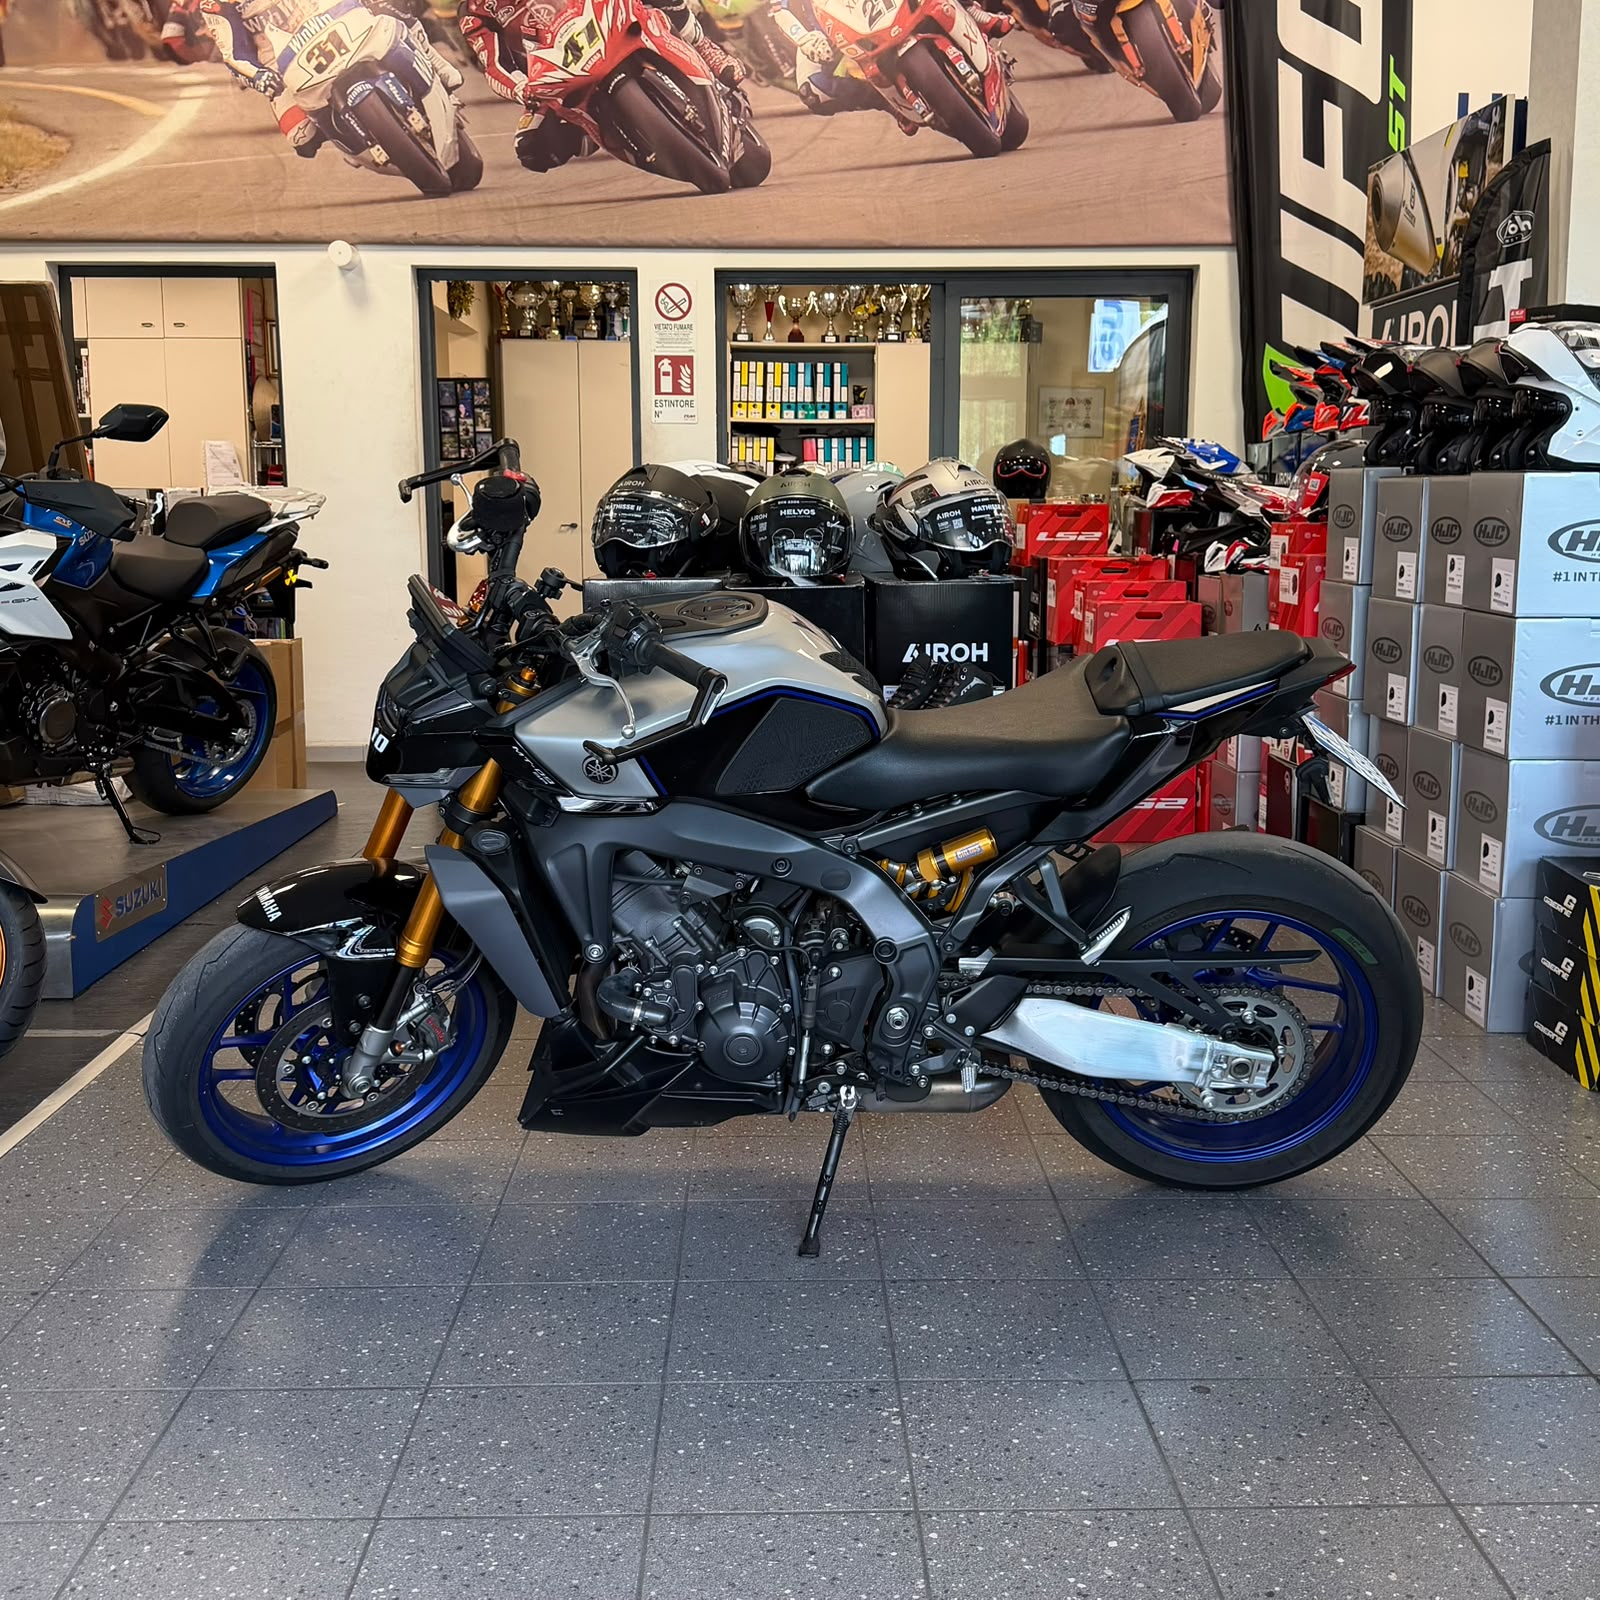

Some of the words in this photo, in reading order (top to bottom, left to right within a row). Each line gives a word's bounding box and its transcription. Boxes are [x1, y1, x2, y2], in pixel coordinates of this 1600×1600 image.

[288, 13, 334, 52] WinWin
[562, 18, 600, 68] 41
[305, 30, 350, 75] 31
[582, 51, 602, 72] YAMAHA
[654, 323, 673, 331] VIETATO
[674, 323, 694, 331] FUMARE
[654, 399, 695, 408] ESTINTORE
[654, 410, 662, 418] N°
[618, 480, 645, 488] AIROH
[750, 513, 768, 522] AIROH
[780, 508, 816, 516] HELYOS
[936, 510, 962, 520] AIROH
[1335, 511, 1352, 524] HJC
[78, 529, 97, 546] SUZ
[1036, 531, 1104, 542] LS2
[1386, 523, 1410, 536] HJC
[1434, 523, 1459, 537] HJC
[1476, 524, 1507, 540] HJC
[1564, 530, 1600, 552] H
[1552, 571, 1571, 583] #1
[1573, 571, 1587, 583] IN
[1324, 622, 1342, 637] HJC
[902, 642, 989, 663] AIROH
[1375, 642, 1399, 658] HJC
[1426, 652, 1451, 668] HJC
[1470, 661, 1500, 680] HJC
[1545, 714, 1563, 726] #1
[1565, 714, 1579, 726] IN
[512, 746, 556, 785] MT-09
[1415, 776, 1440, 796] HJC
[1133, 797, 1188, 809] S2
[1467, 797, 1495, 821] HJC
[115, 879, 163, 918] SUZUKI
[256, 885, 282, 923] YAMAHA
[1565, 894, 1577, 910] G
[1405, 900, 1429, 923] HJC
[1453, 925, 1478, 951] HJC
[1561, 957, 1574, 974] G
[1554, 1021, 1568, 1037] G
